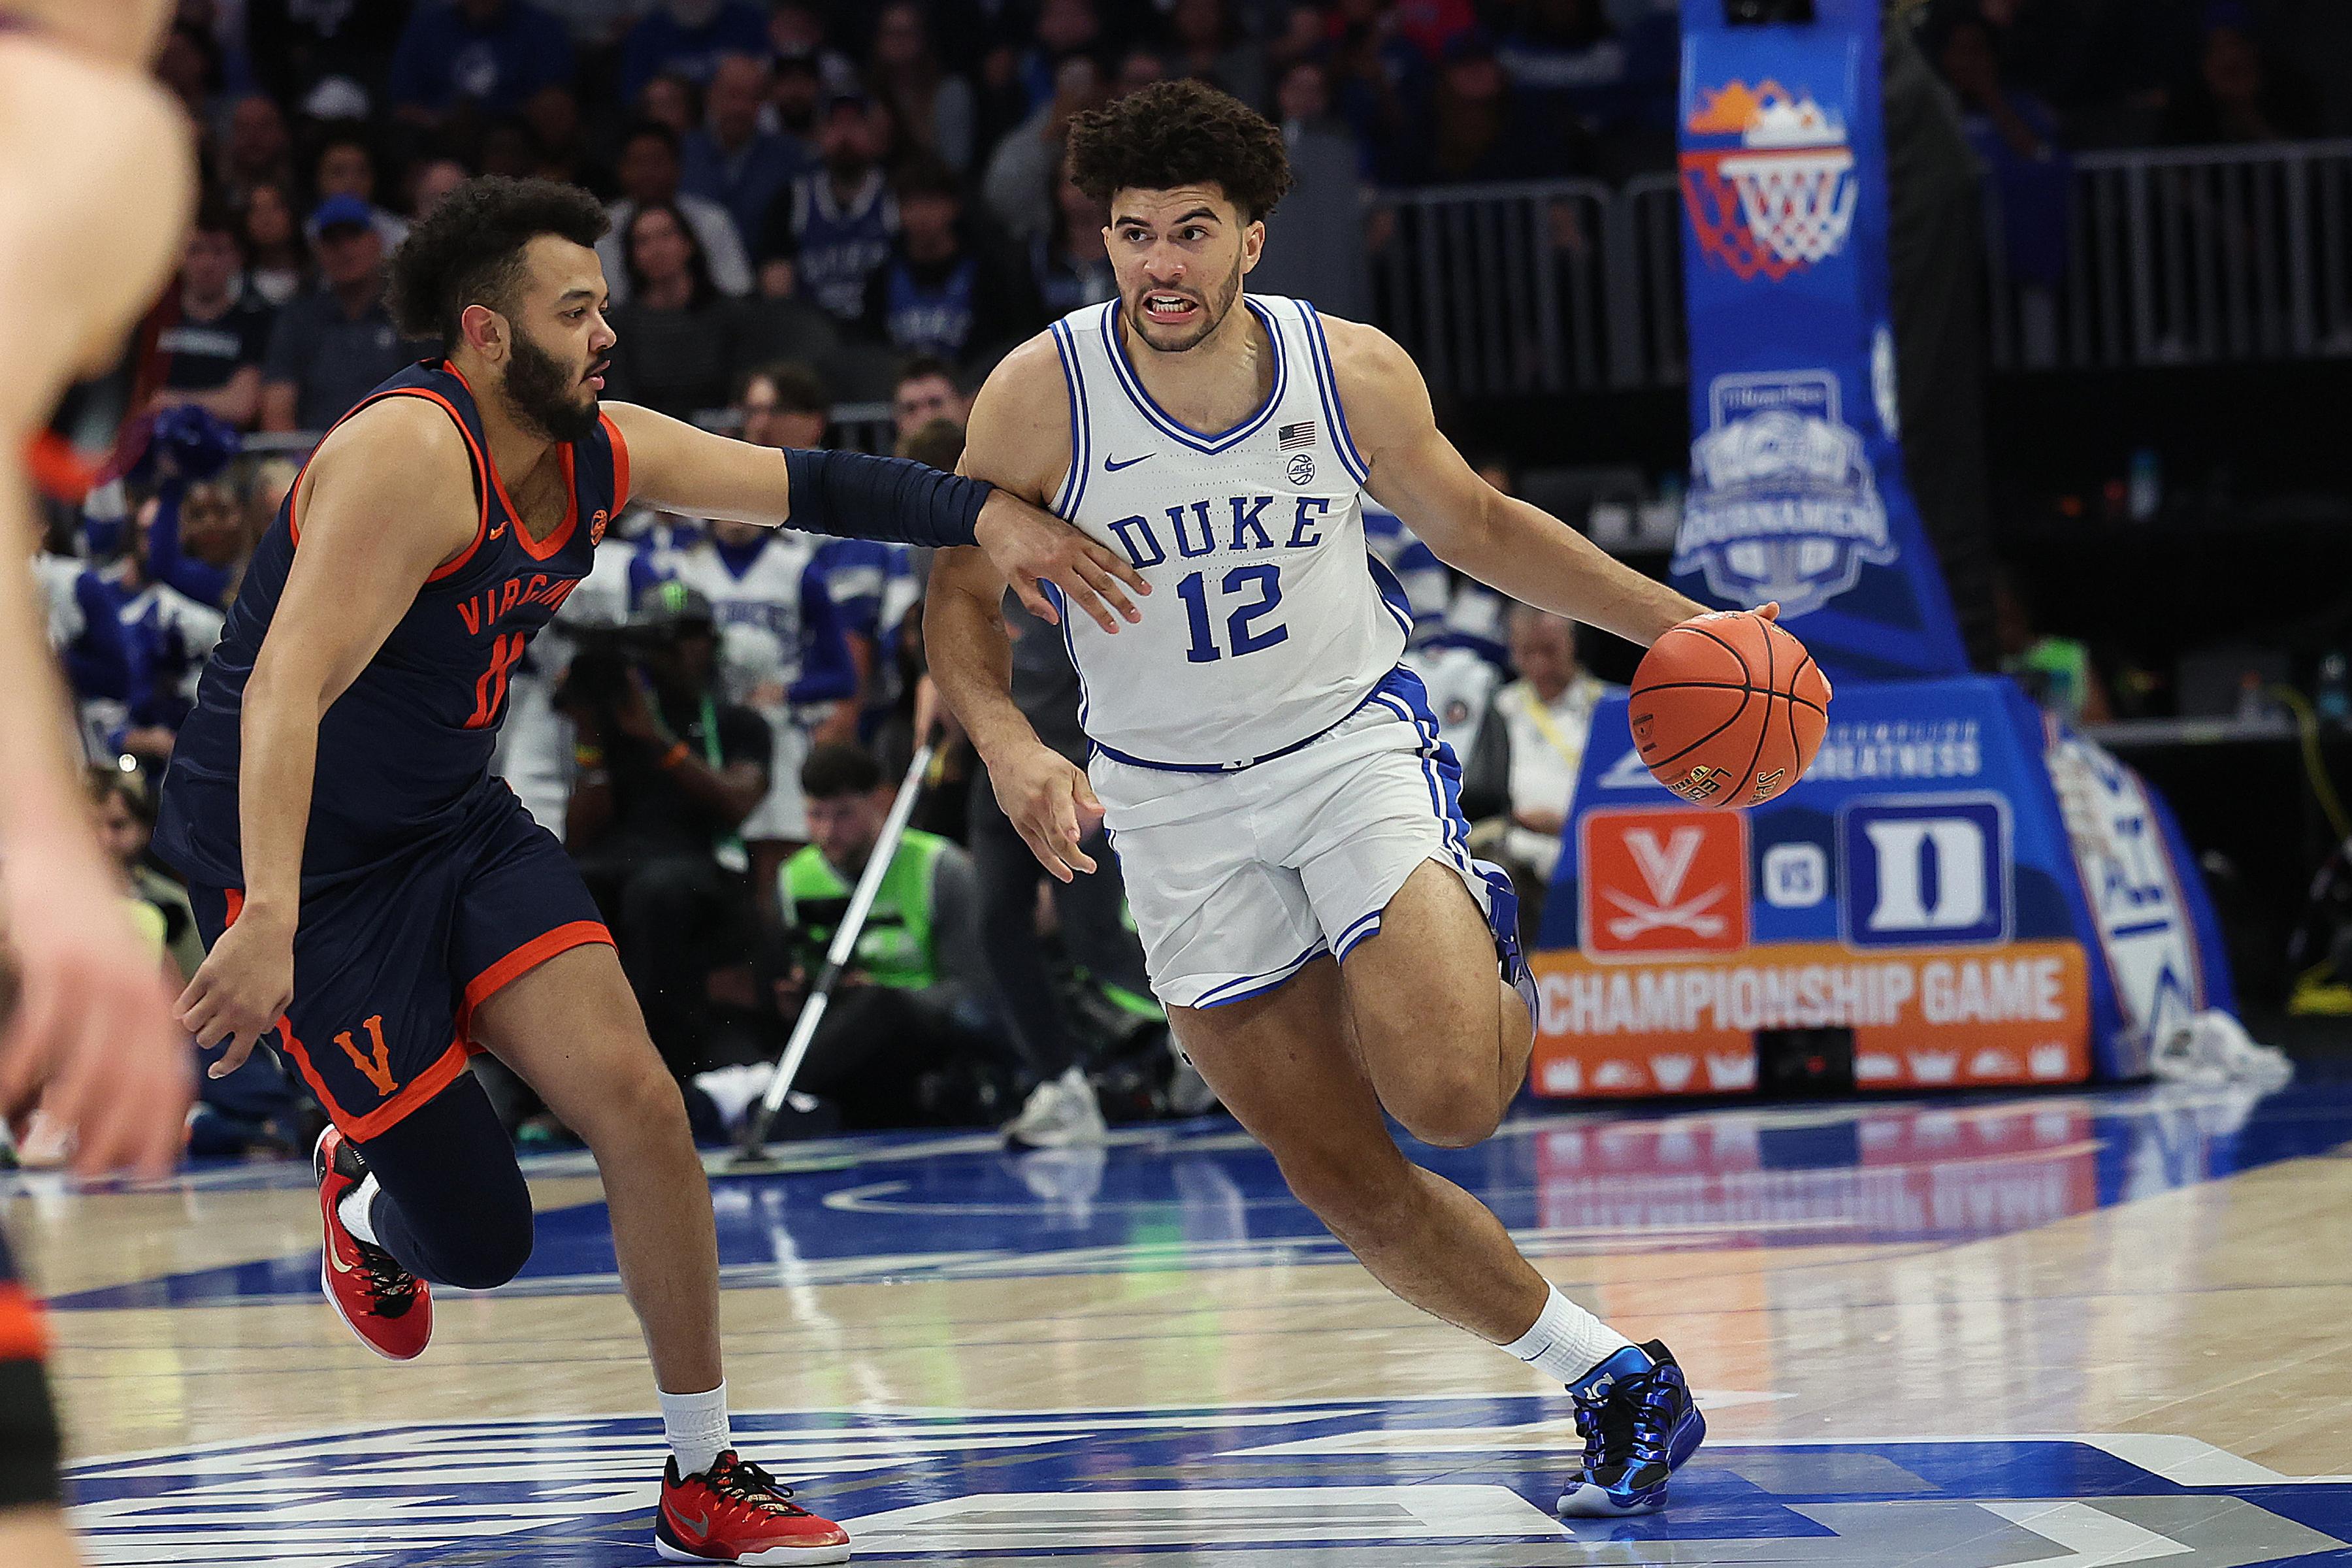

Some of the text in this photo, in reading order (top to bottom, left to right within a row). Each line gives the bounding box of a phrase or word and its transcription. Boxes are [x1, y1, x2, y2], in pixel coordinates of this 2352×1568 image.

[1291, 463, 1313, 472] ACC
[1107, 497, 1330, 570] DUKE
[1177, 564, 1288, 662] 12
[1865, 819, 1986, 932] D
[1539, 958, 2067, 1035] CHAMPIONSHIP GAME
[334, 1015, 399, 1096] V
